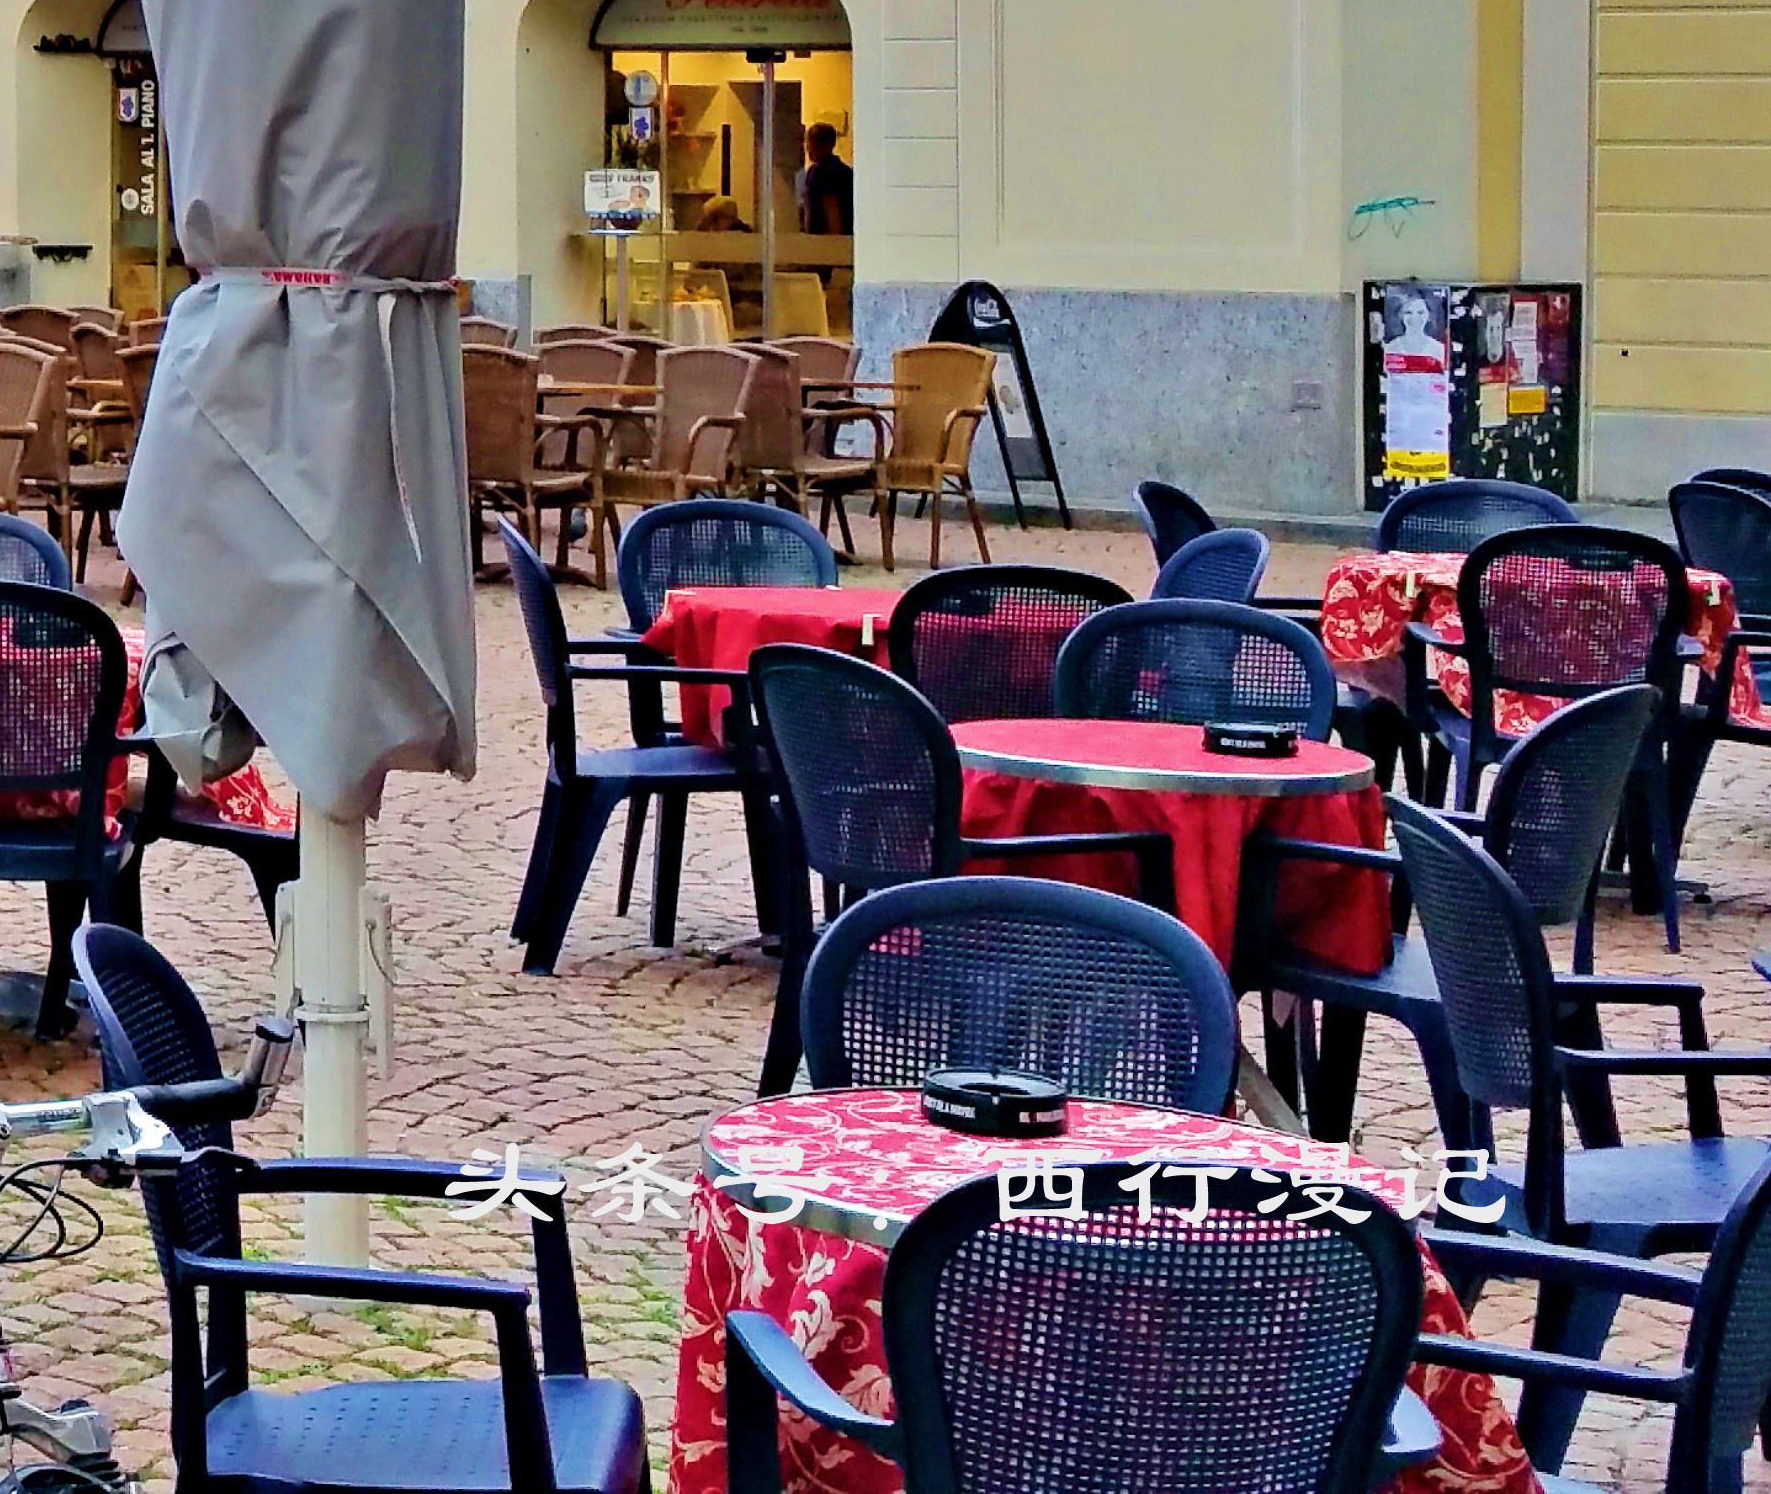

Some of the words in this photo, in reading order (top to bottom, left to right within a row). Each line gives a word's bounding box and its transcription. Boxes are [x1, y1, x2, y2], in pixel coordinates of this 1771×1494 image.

[141, 79, 155, 128] PIANO
[141, 147, 155, 168] AL
[141, 174, 155, 216] SALA
